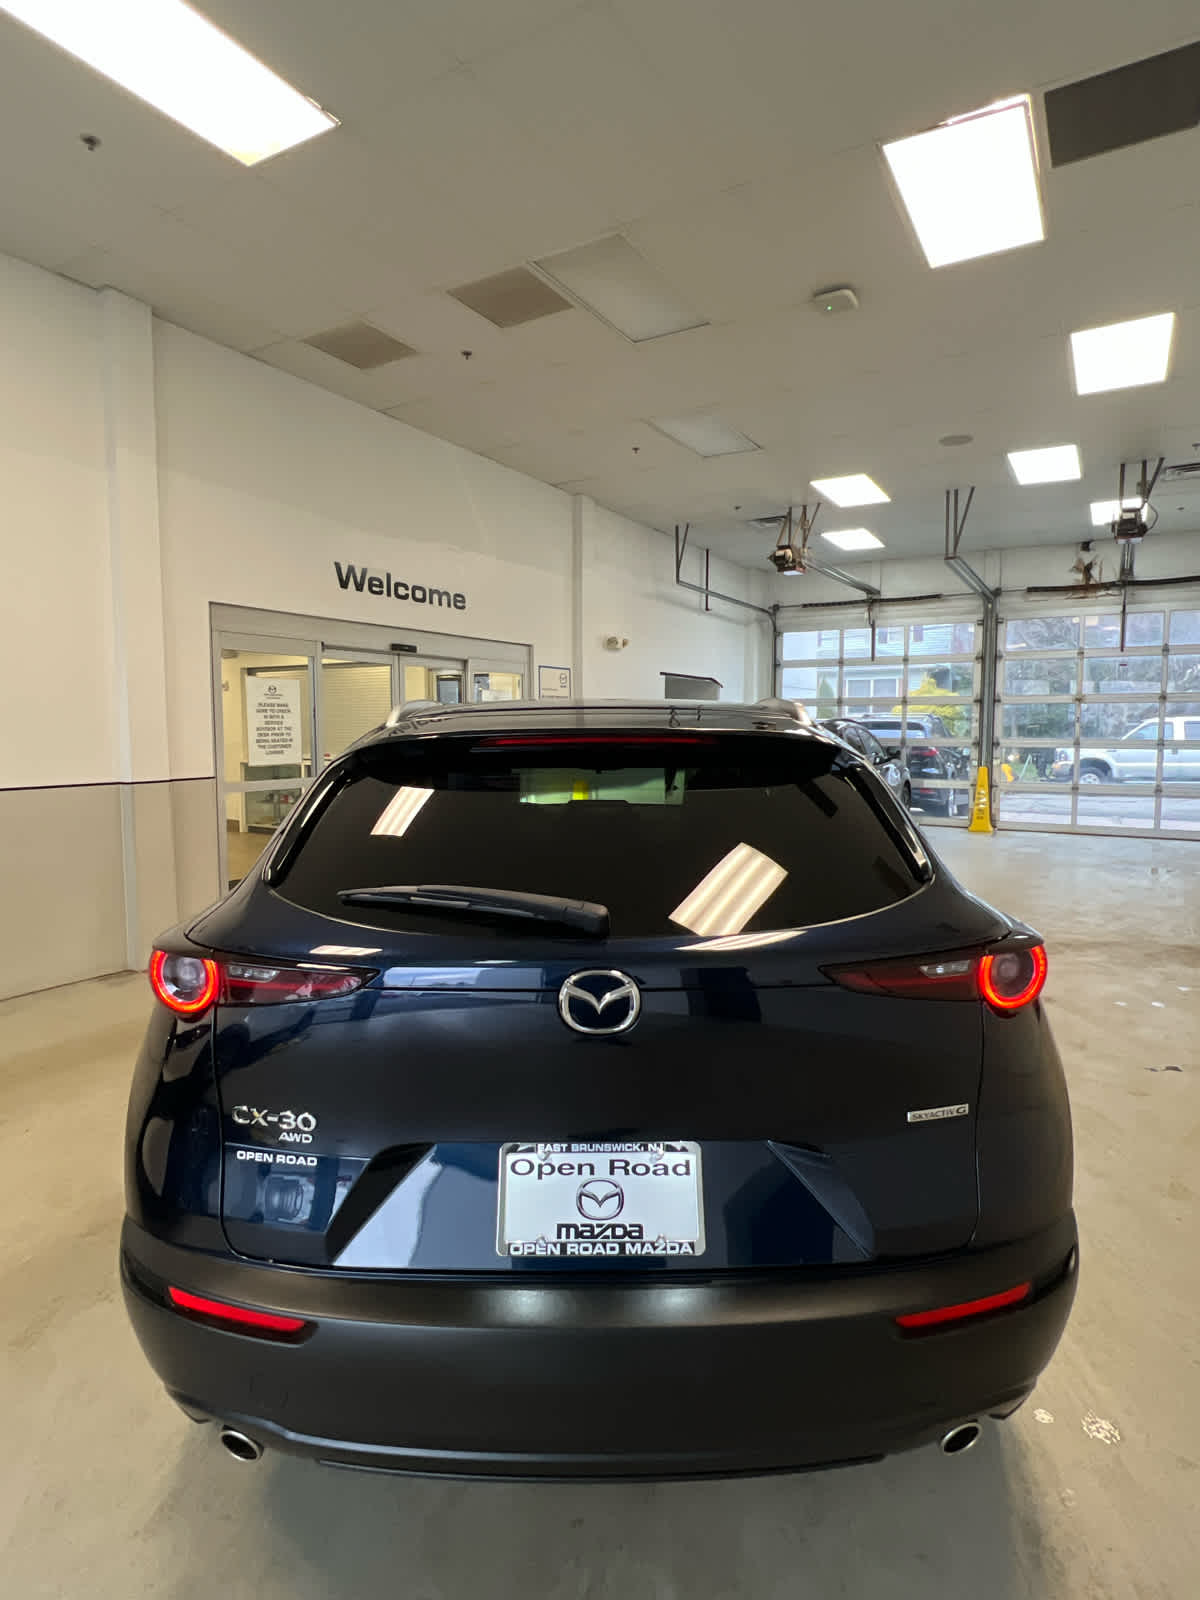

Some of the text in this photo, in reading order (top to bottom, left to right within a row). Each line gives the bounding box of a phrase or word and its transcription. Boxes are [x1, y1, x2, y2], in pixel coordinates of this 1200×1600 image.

[334, 561, 466, 610] Welcome
[232, 1105, 317, 1132] CX-30
[278, 1132, 313, 1143] AWD
[537, 1143, 568, 1152] EAST
[647, 1143, 664, 1152] NJ
[236, 1150, 318, 1166] OPEN ROAD
[510, 1159, 690, 1180] Open Road
[510, 1241, 693, 1255] OPEN ROAD MAZDA
